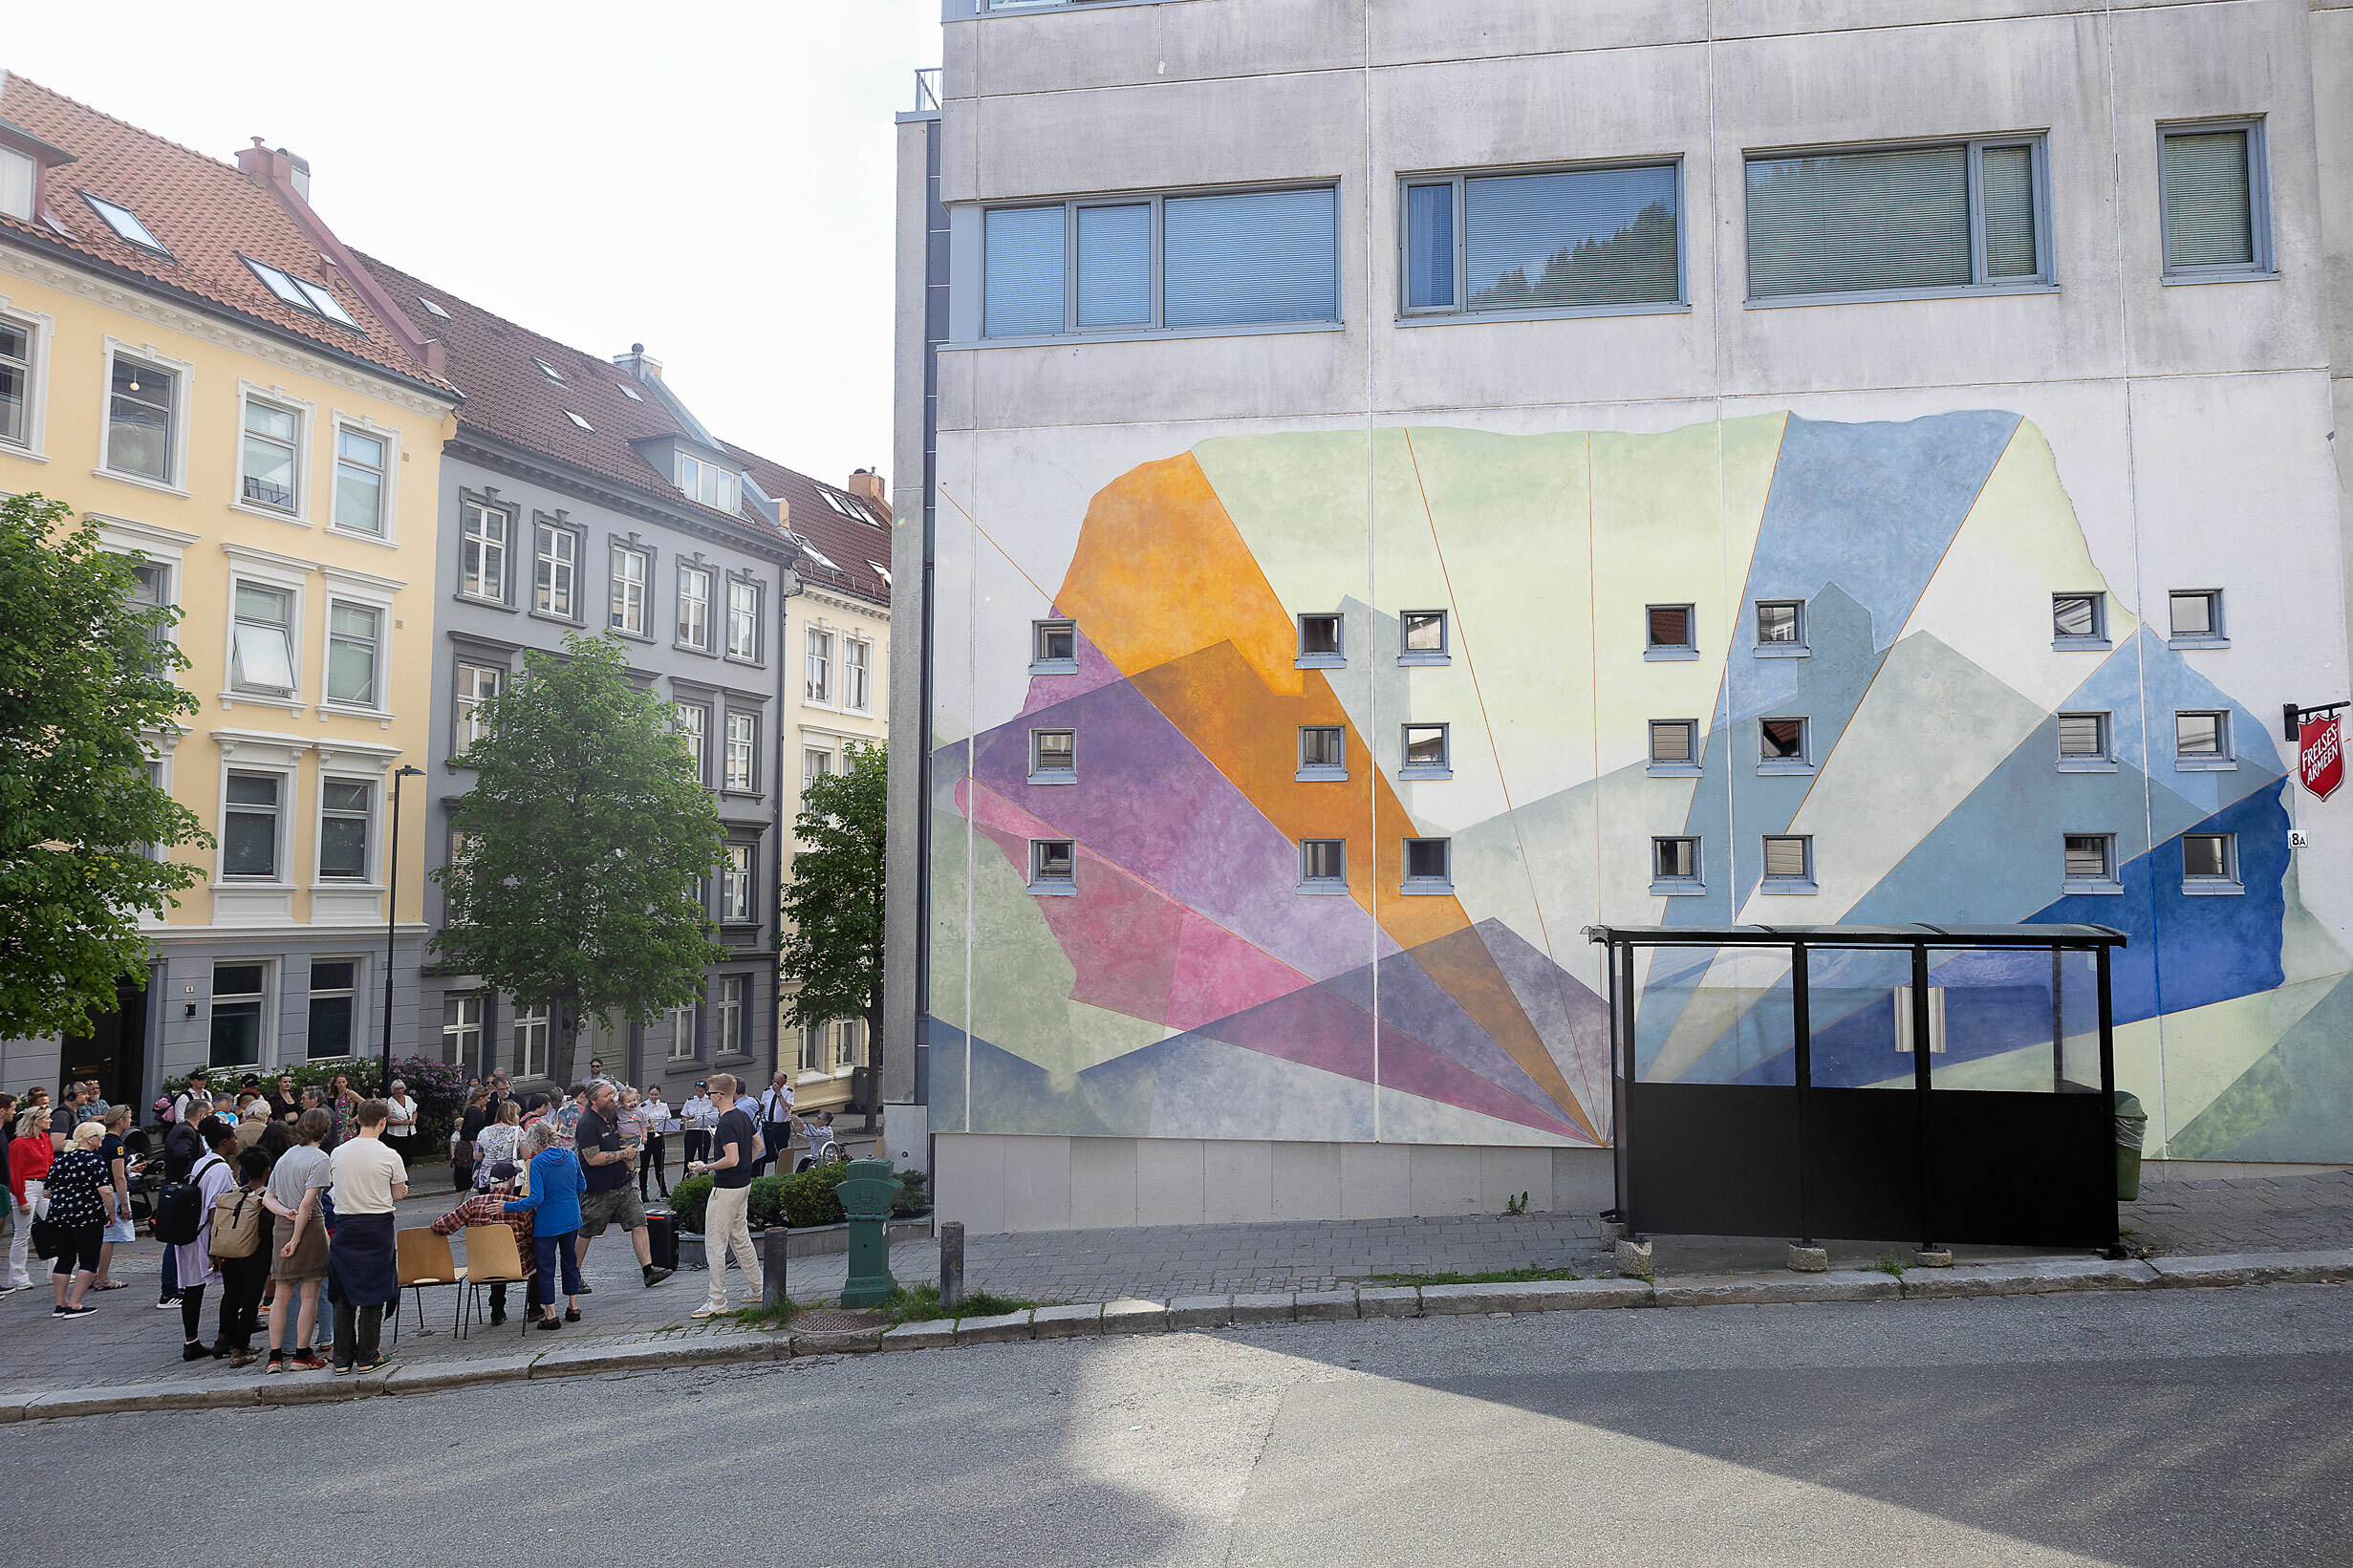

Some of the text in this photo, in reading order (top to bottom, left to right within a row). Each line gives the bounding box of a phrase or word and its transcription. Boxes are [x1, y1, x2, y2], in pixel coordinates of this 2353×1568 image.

[2302, 723, 2338, 772] FRELSES-
[2307, 741, 2339, 785] ARMEEN
[2292, 833, 2305, 846] 8A
